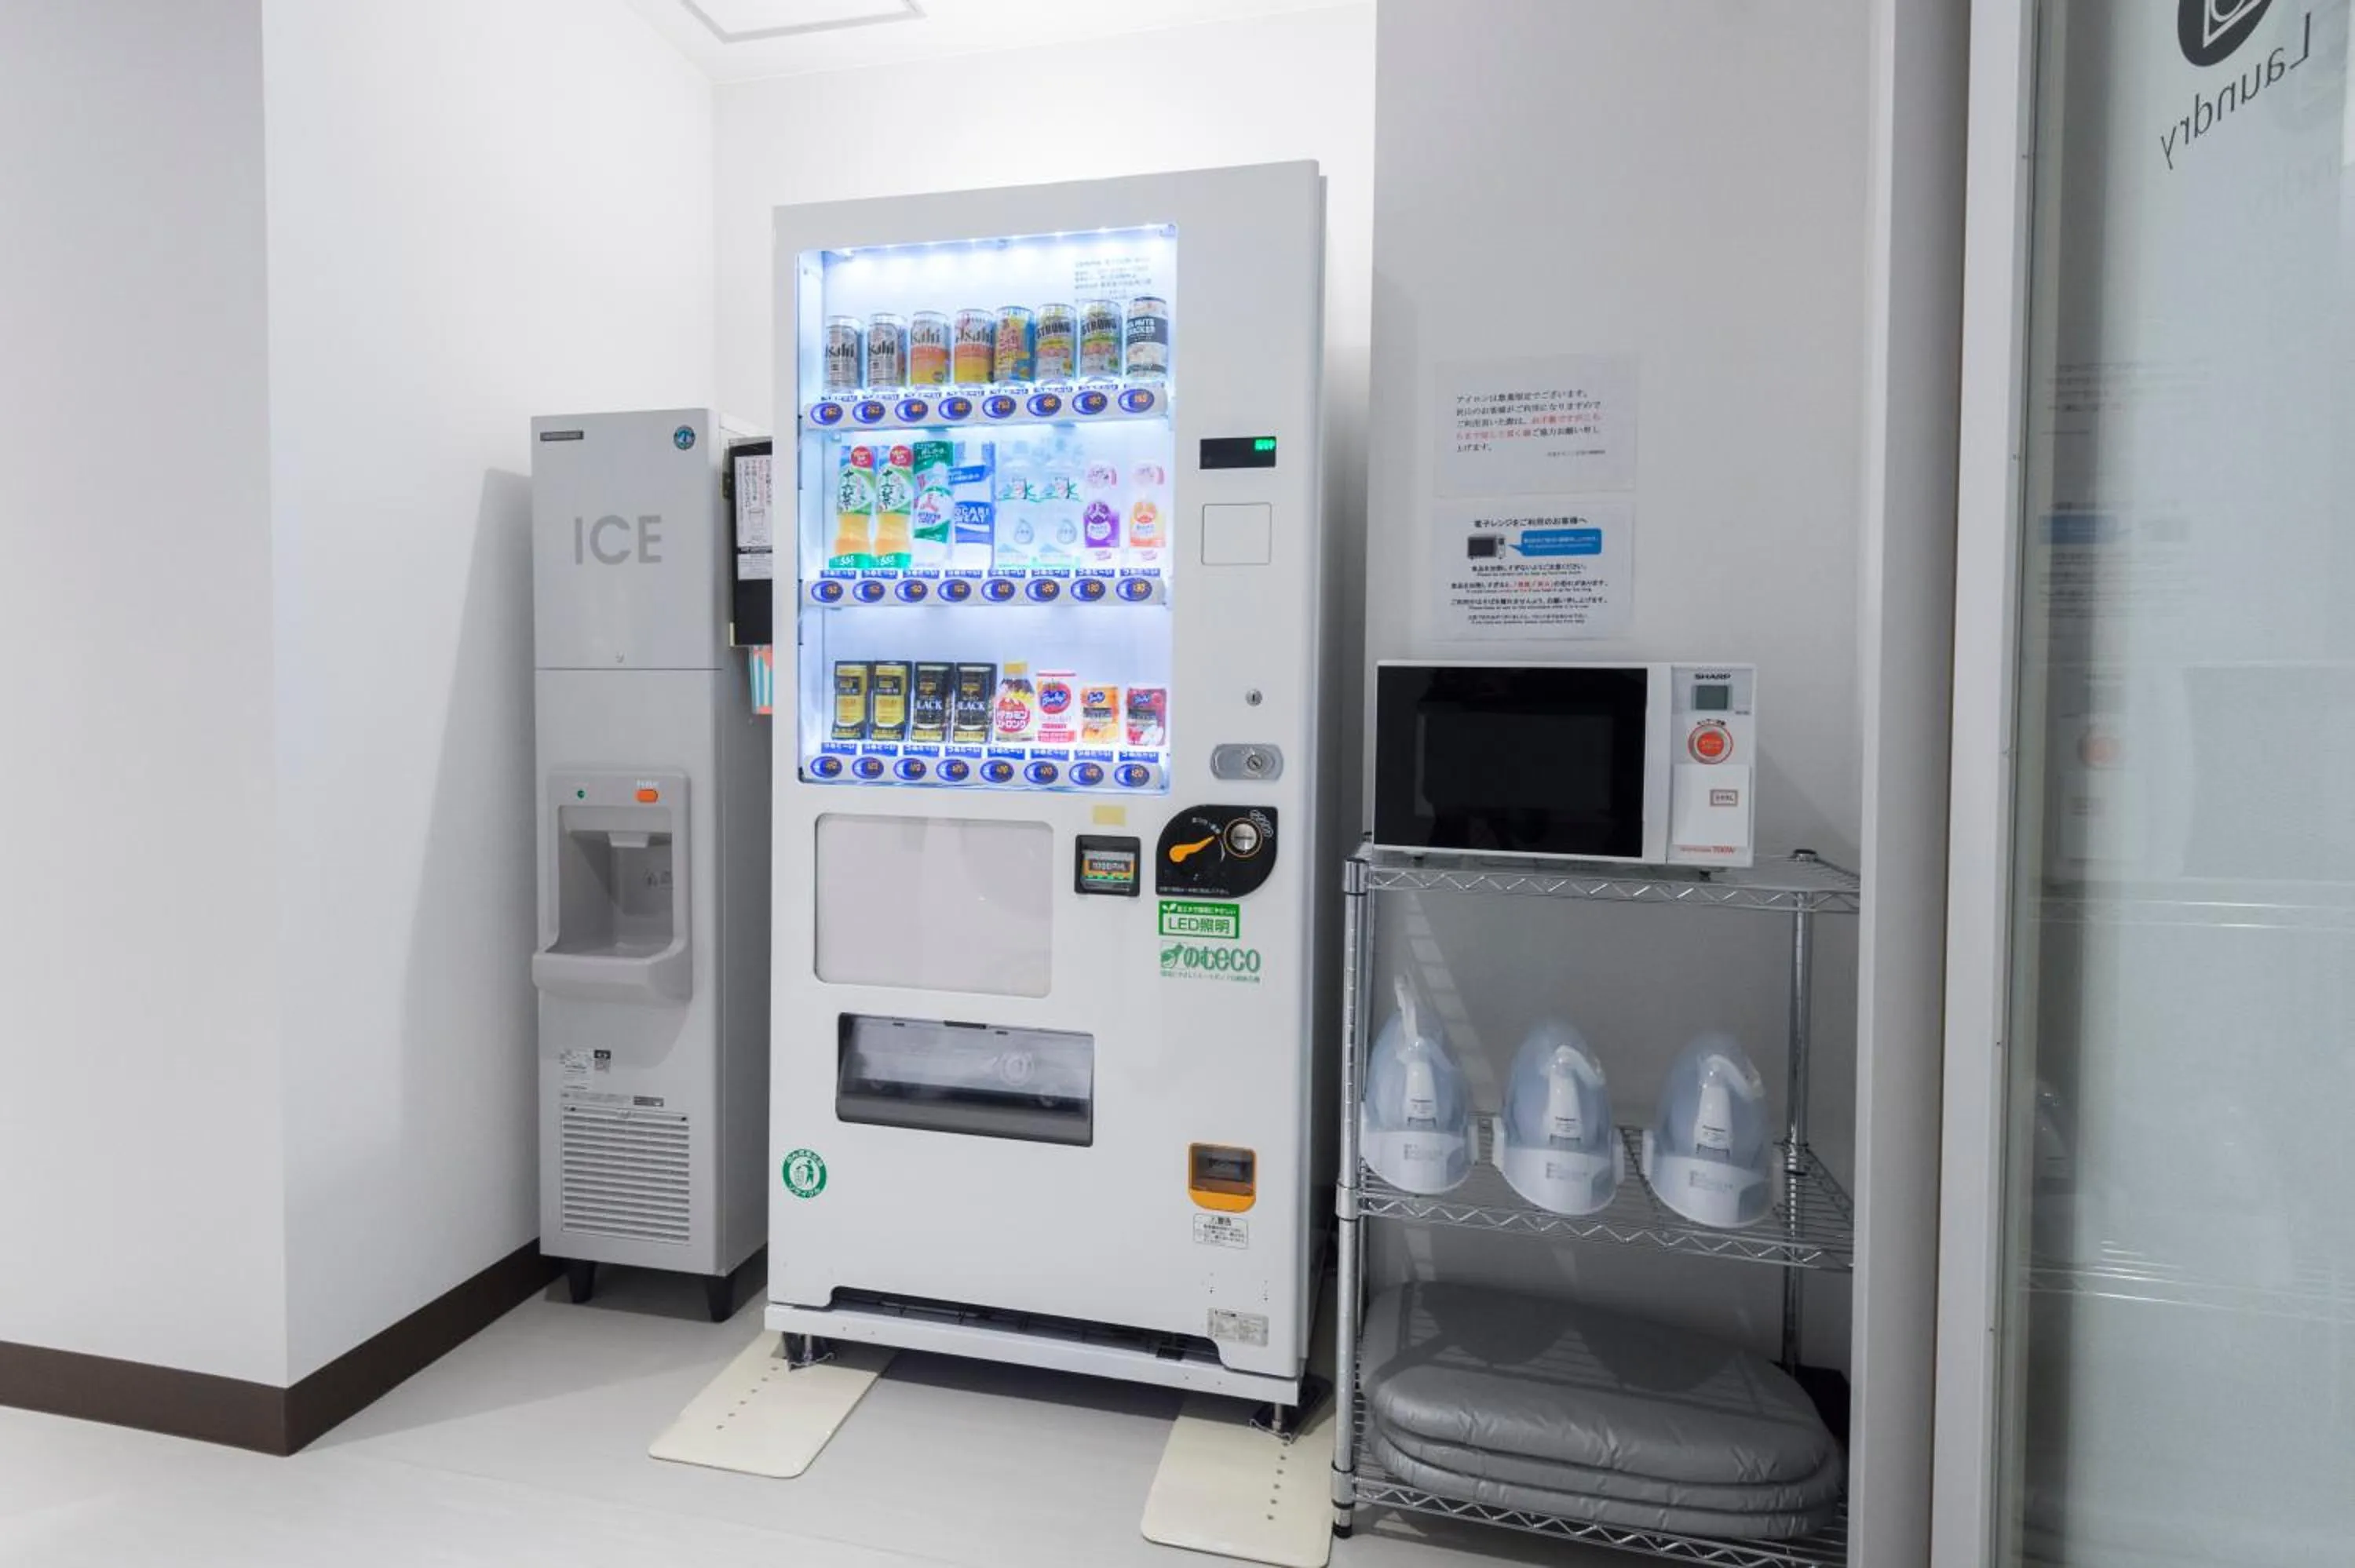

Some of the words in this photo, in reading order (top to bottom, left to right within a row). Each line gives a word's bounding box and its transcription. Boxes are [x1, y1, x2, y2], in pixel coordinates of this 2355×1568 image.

[911, 327, 940, 344] sahi
[826, 342, 855, 359] sahi
[869, 340, 895, 356] sahi
[955, 505, 990, 516] OCARI
[574, 515, 663, 566] ICE
[917, 701, 942, 709] LACK
[1169, 916, 1230, 934] LED照明
